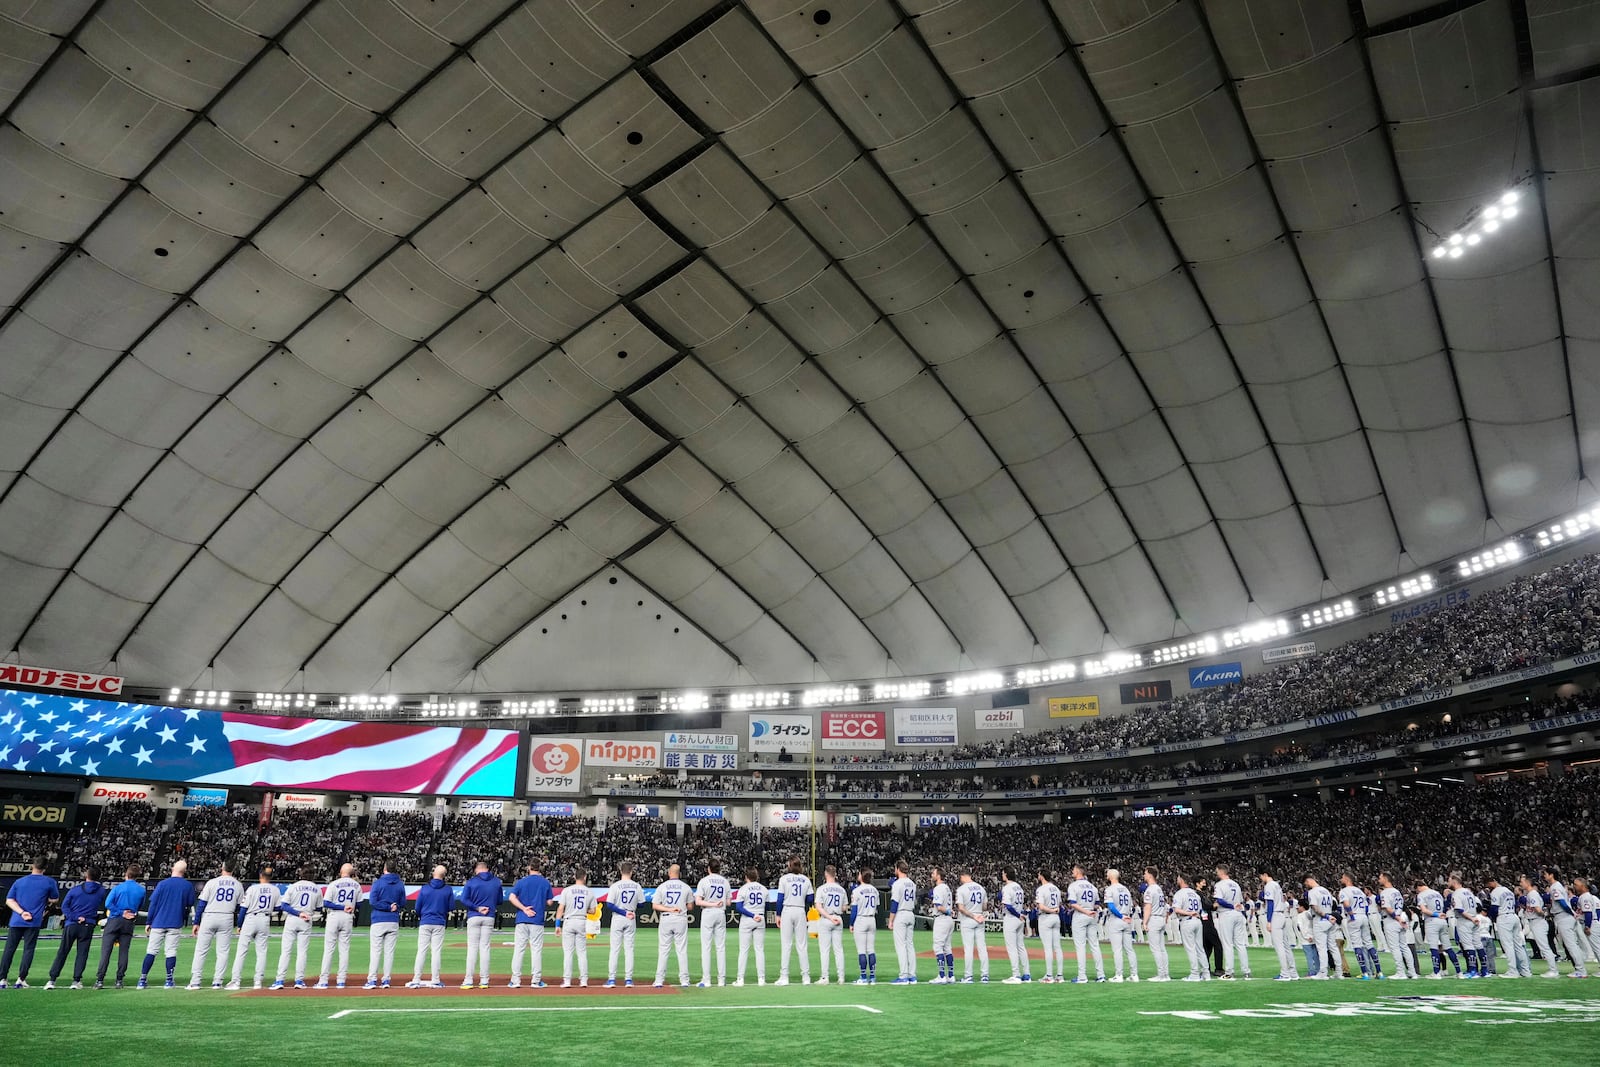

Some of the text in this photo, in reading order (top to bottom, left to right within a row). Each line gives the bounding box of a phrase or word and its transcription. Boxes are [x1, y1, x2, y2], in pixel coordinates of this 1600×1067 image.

[1447, 588, 1471, 607] 日本
[0, 667, 120, 692] オロナミンC
[985, 711, 1013, 722] azbil
[772, 724, 810, 736] ダイダン
[829, 721, 878, 738] ECC
[678, 735, 734, 745] あんしん財団
[590, 741, 656, 763] nippn
[666, 753, 736, 768] 能美防災
[535, 776, 573, 787] シマダヤ
[3, 805, 67, 823] RYOBI
[685, 808, 720, 816] SAISON
[920, 815, 958, 825] TOTO
[216, 888, 235, 902] 88
[338, 889, 355, 903] 84
[710, 886, 724, 899] 79
[792, 884, 803, 897] 31
[904, 889, 914, 902] 64
[1081, 890, 1094, 903] 49
[1231, 889, 1236, 901] 7
[259, 895, 272, 909] 91
[300, 893, 310, 907] 0
[574, 896, 585, 910] 15
[621, 891, 635, 904] 67
[666, 892, 681, 904] 57
[749, 893, 763, 905] 96
[828, 894, 841, 907] 78
[865, 896, 876, 908] 70
[970, 892, 982, 905] 43
[1119, 894, 1129, 906] 66
[1321, 896, 1332, 908] 44
[1353, 896, 1365, 909] 72
[1188, 898, 1199, 911] 38
[1435, 899, 1441, 911] 8
